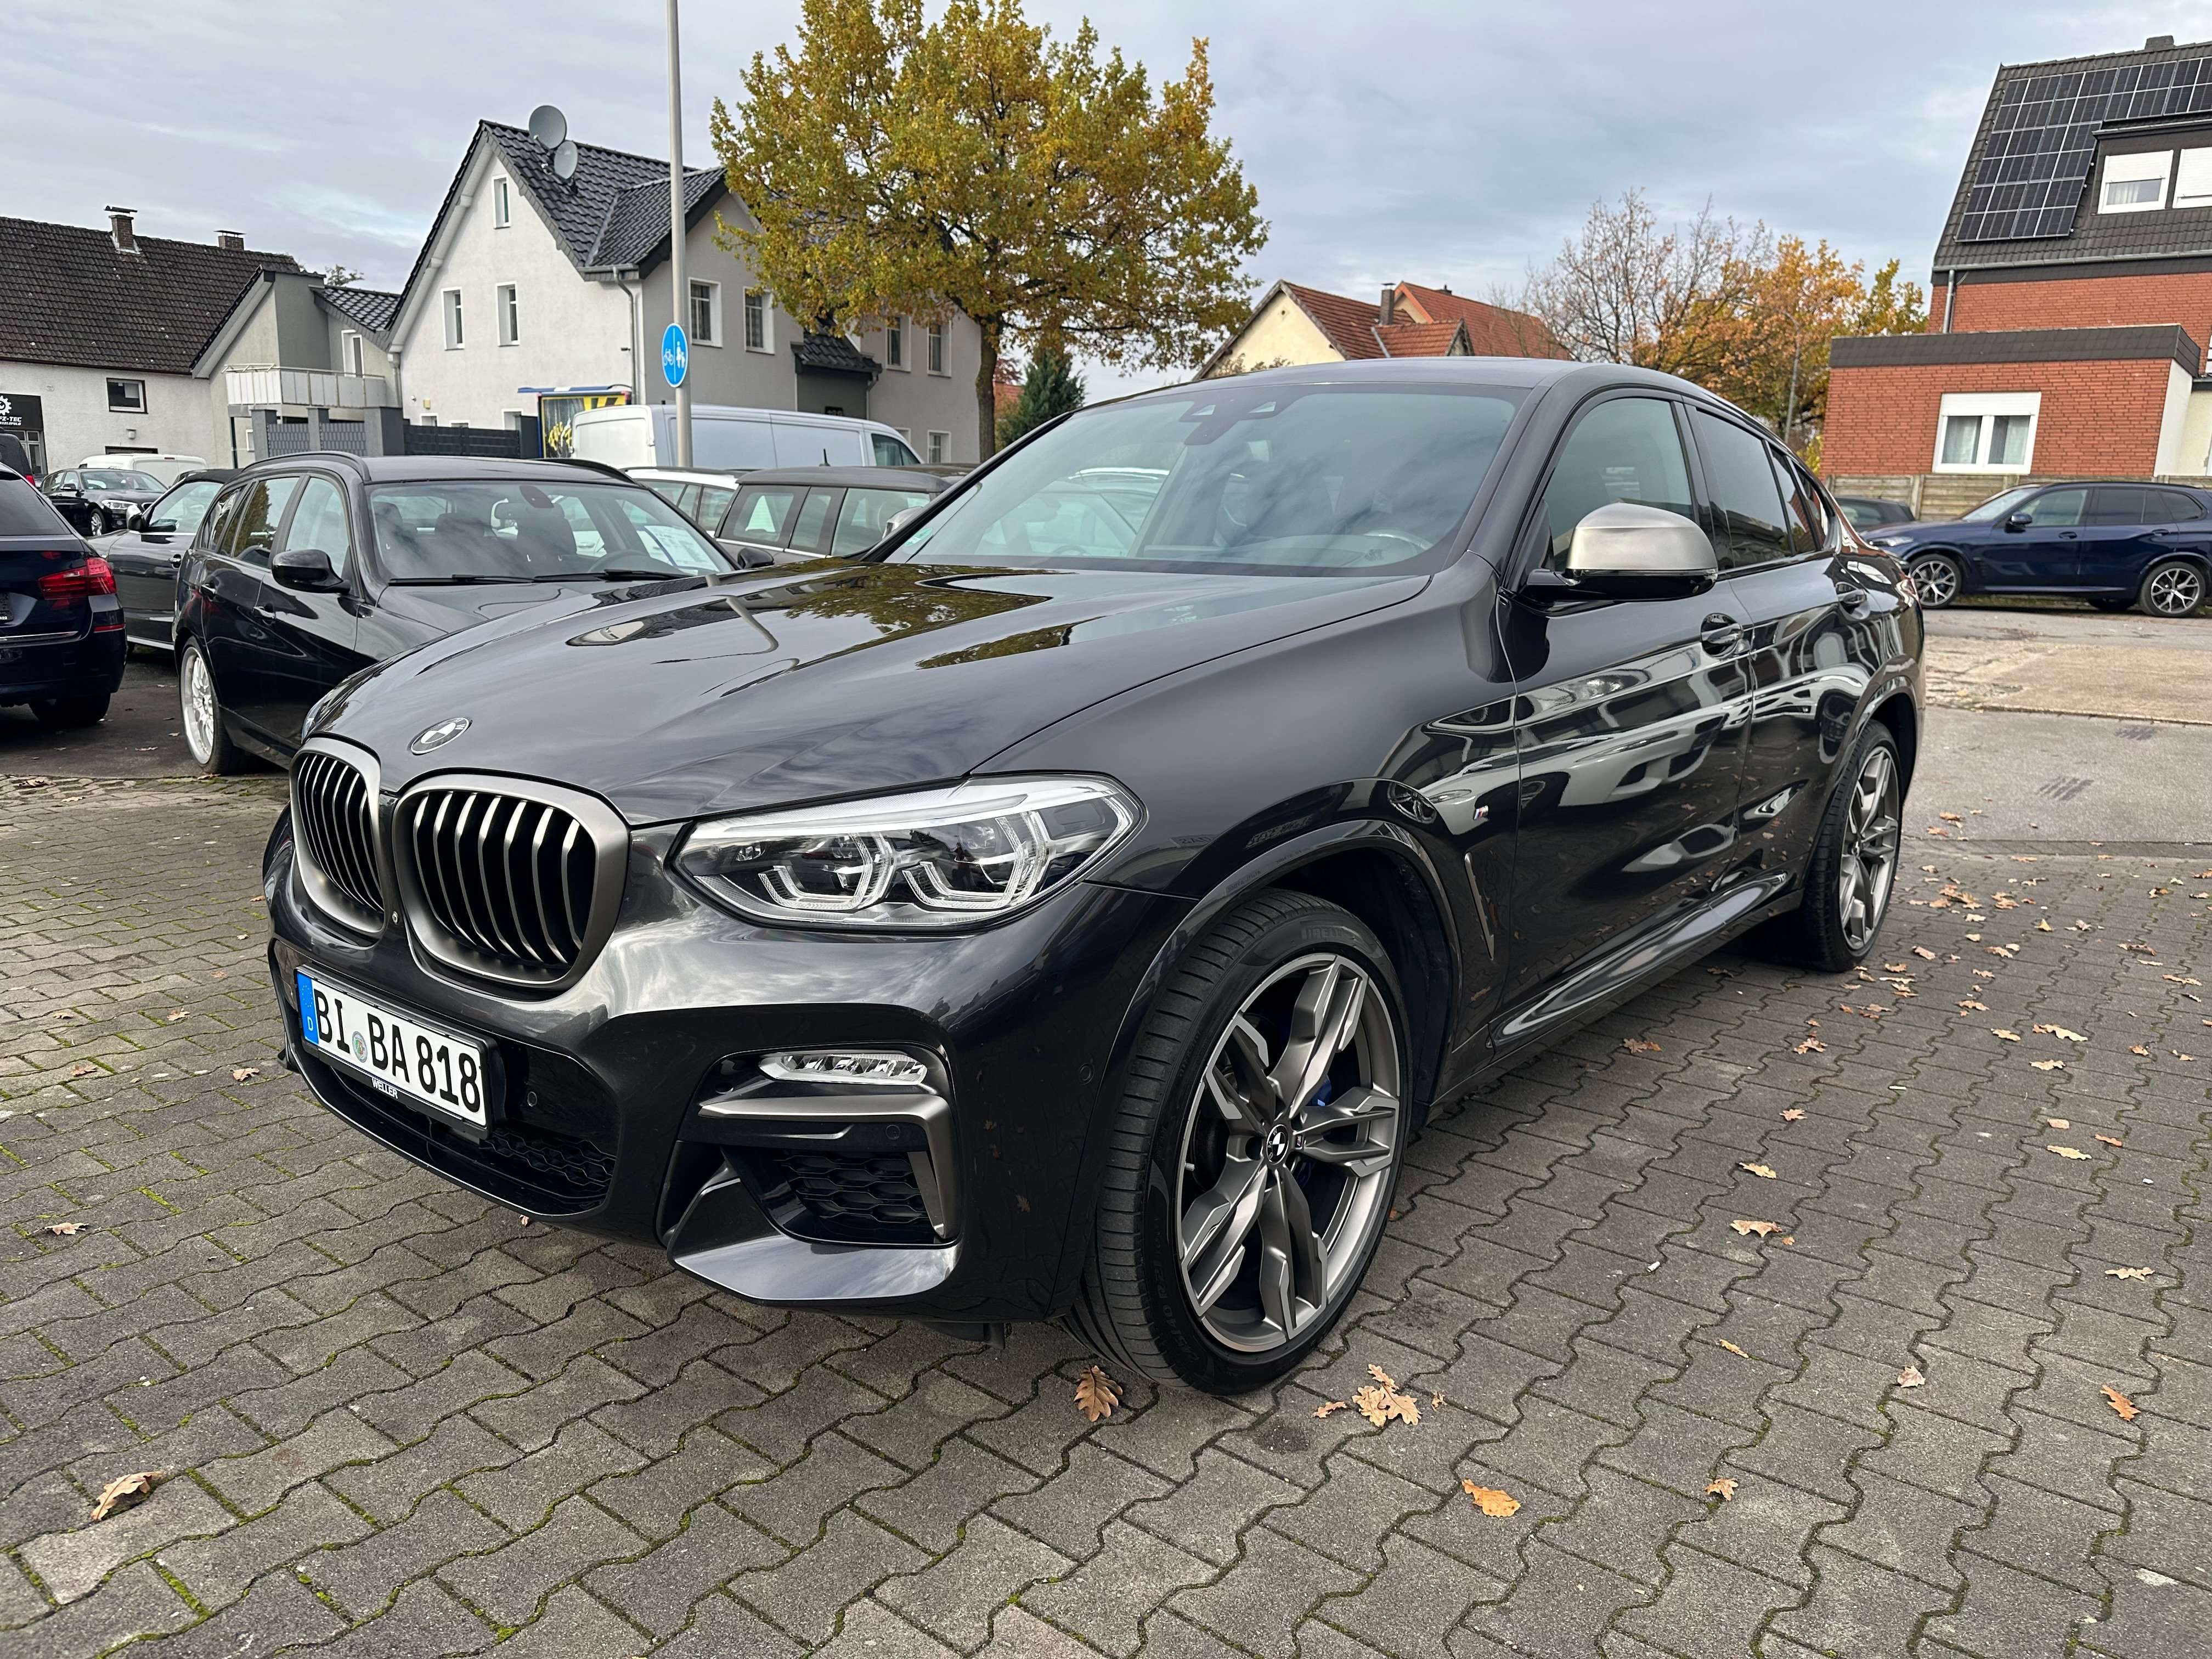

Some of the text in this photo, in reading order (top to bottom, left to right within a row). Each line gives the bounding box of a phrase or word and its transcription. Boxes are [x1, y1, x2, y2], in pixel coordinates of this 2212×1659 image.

[307, 1016, 313, 1031] D
[314, 989, 480, 1113] BI BA 818
[371, 1077, 398, 1099] WELLER
